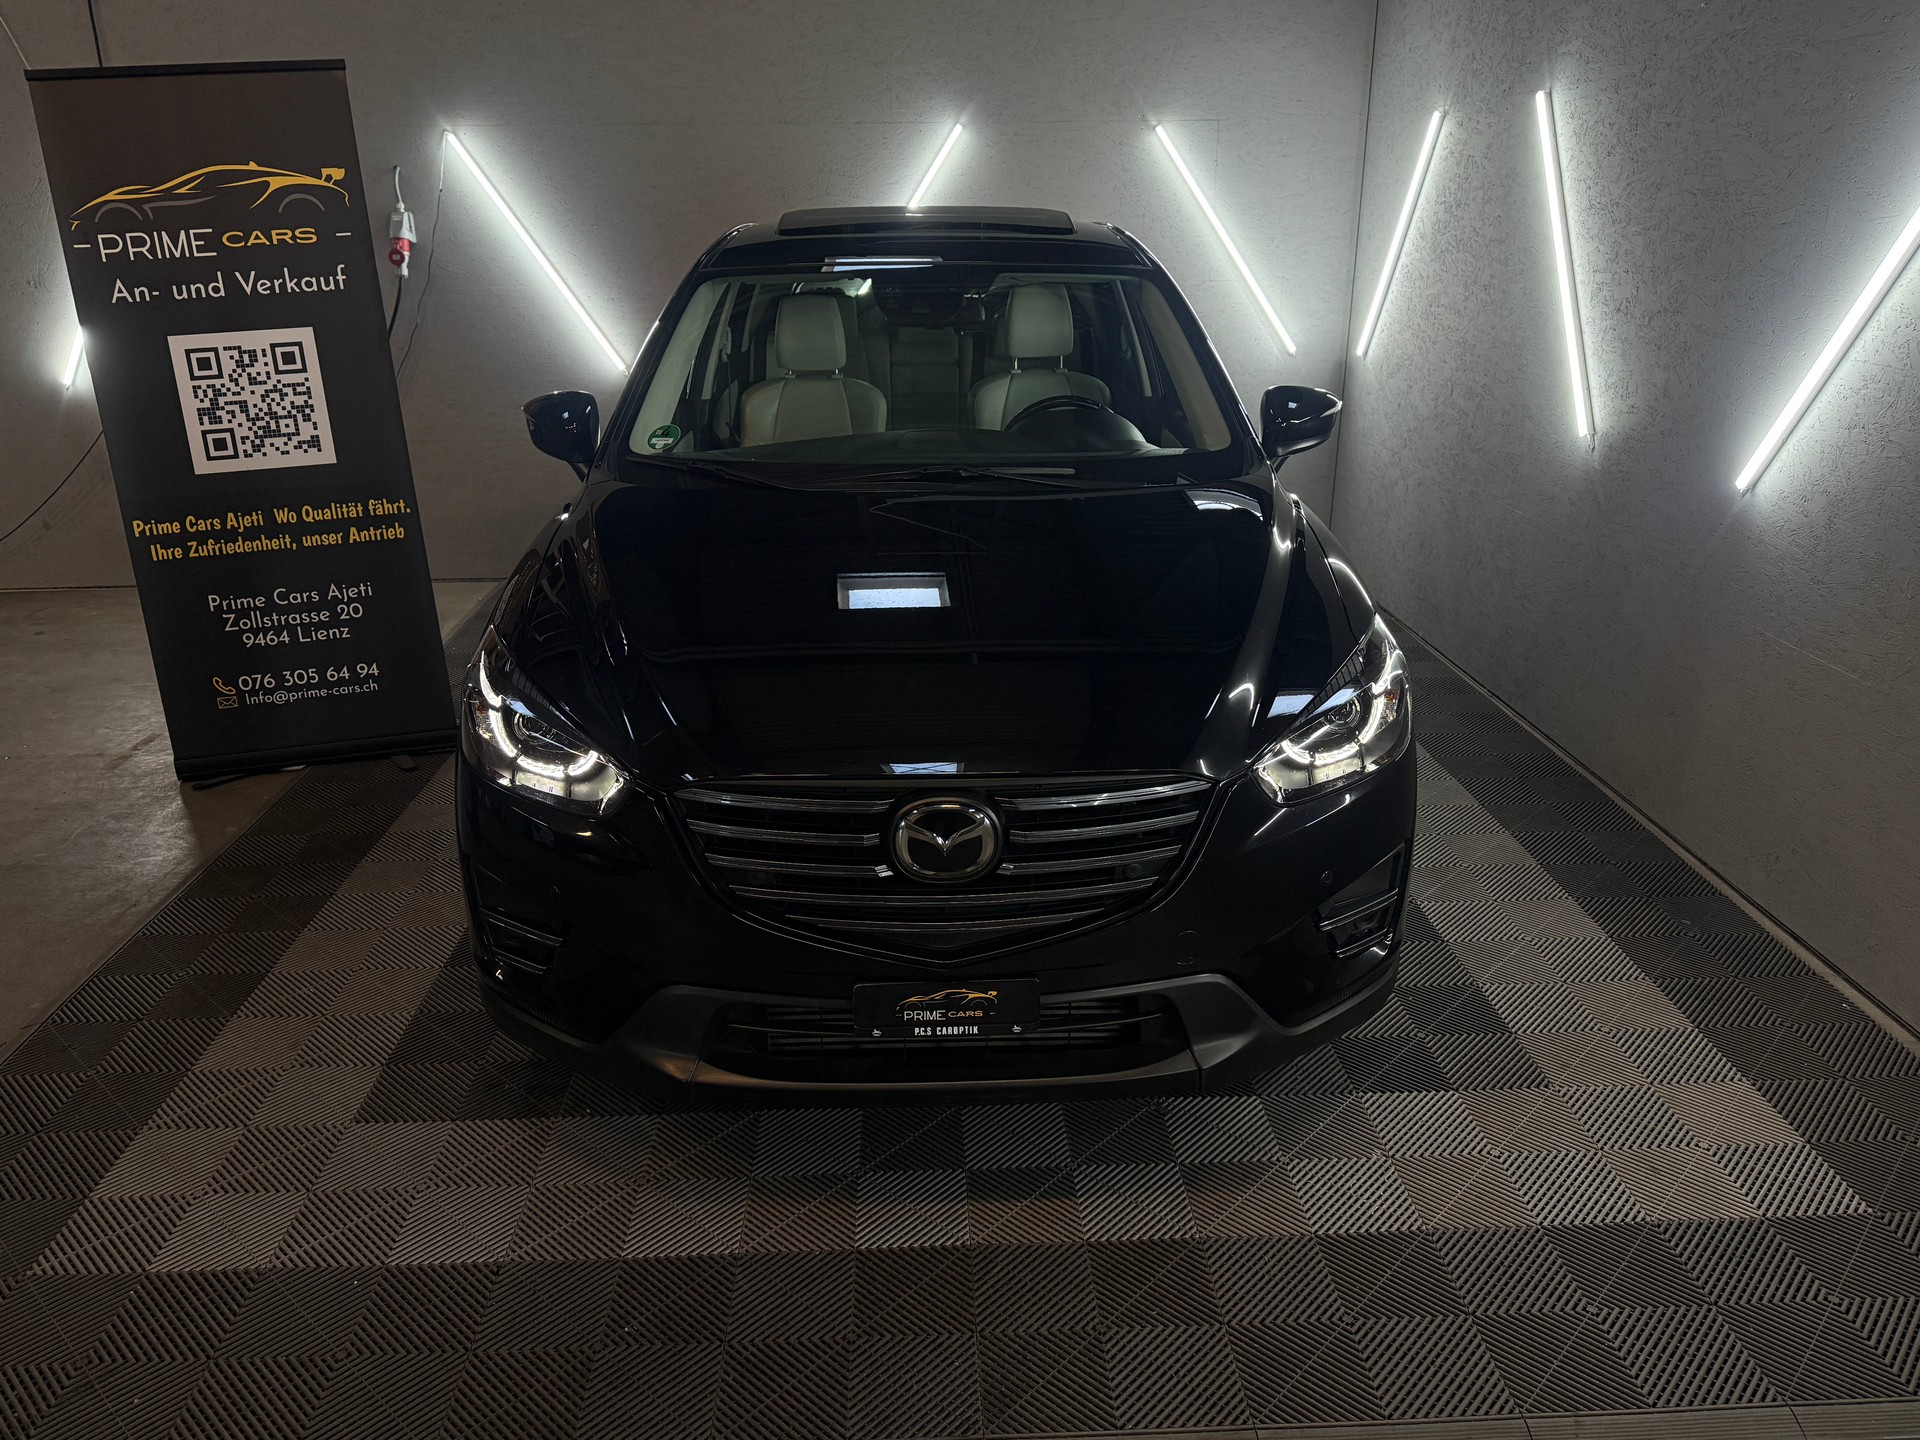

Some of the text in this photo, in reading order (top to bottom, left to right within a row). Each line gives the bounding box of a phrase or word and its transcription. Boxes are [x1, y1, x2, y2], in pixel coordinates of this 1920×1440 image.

[97, 228, 318, 262] PRIME CARS
[112, 264, 347, 304] An- und Verkauf
[132, 498, 411, 538] Prime Cars Ajeti Wo Qualität fährt.
[150, 523, 405, 561] Ihre Zufriedenheit, unser Antrieb
[208, 582, 373, 612] Prime Cars Ajeti
[223, 603, 363, 632] Zollstrasse 20
[242, 626, 351, 648] 9464 Lienz
[238, 663, 380, 691] 076 305 64 94
[245, 680, 378, 706] Info@prime-cars.ch
[904, 1010, 946, 1021] PRIME
[937, 1026, 979, 1035] CAROPTIK
